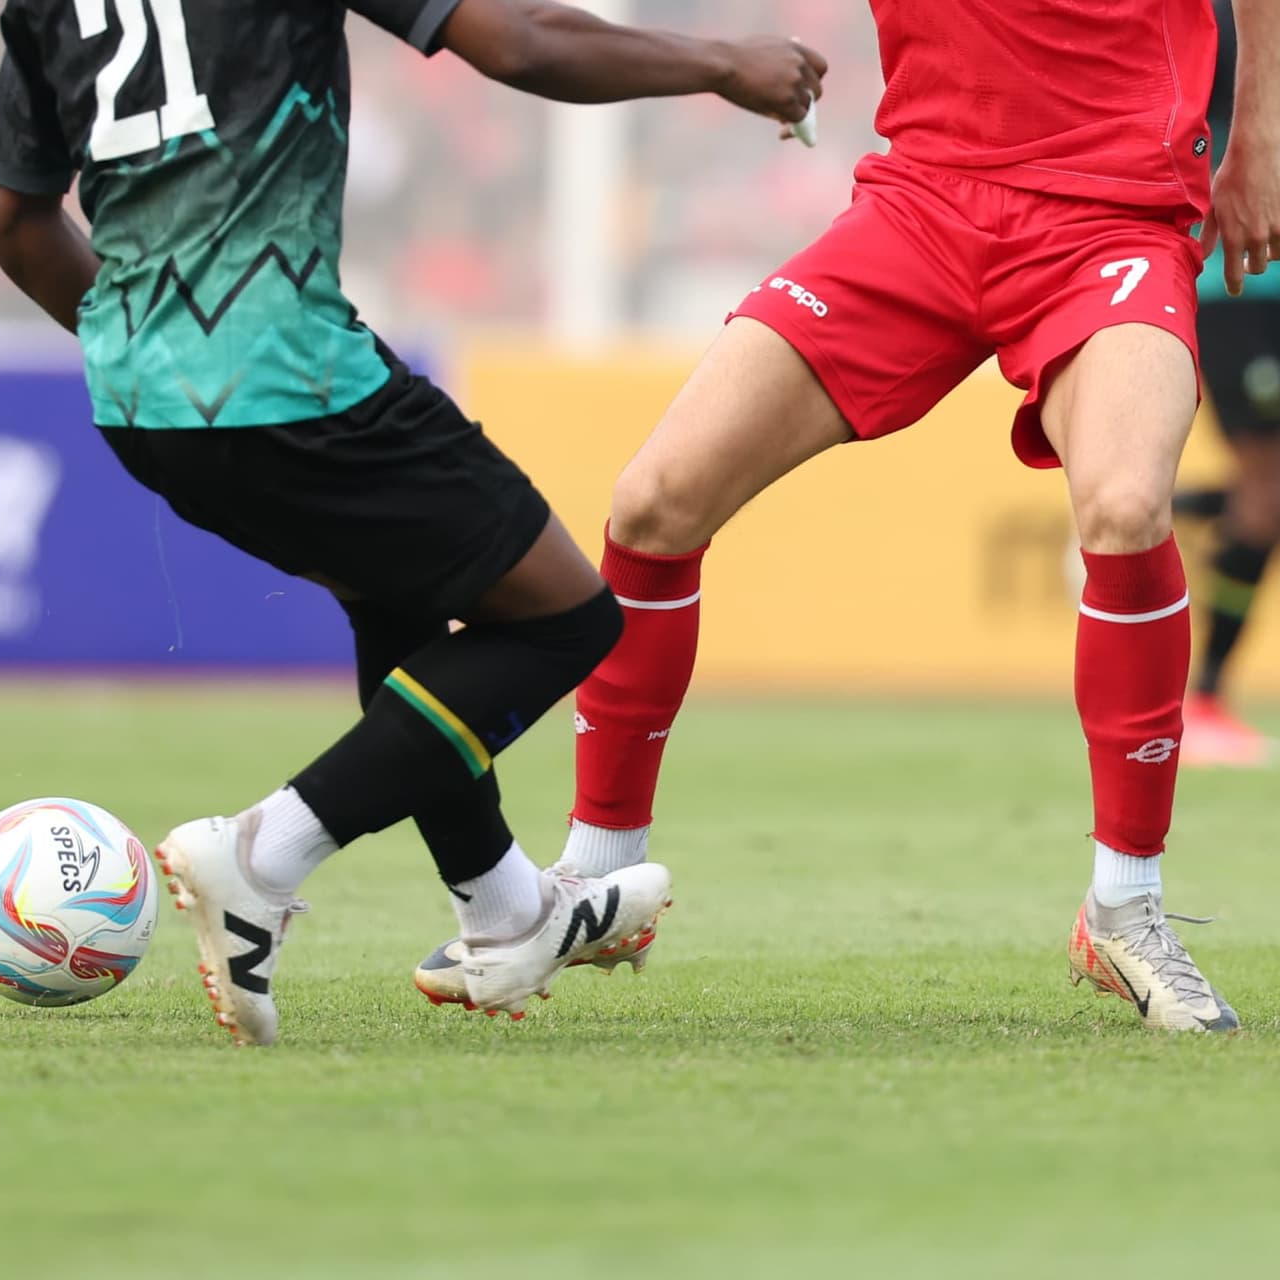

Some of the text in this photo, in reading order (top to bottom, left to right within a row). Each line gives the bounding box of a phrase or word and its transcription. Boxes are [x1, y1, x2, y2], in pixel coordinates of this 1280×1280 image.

[768, 276, 828, 318] erspo
[1100, 256, 1150, 307] 7
[50, 826, 82, 893] SPECS
